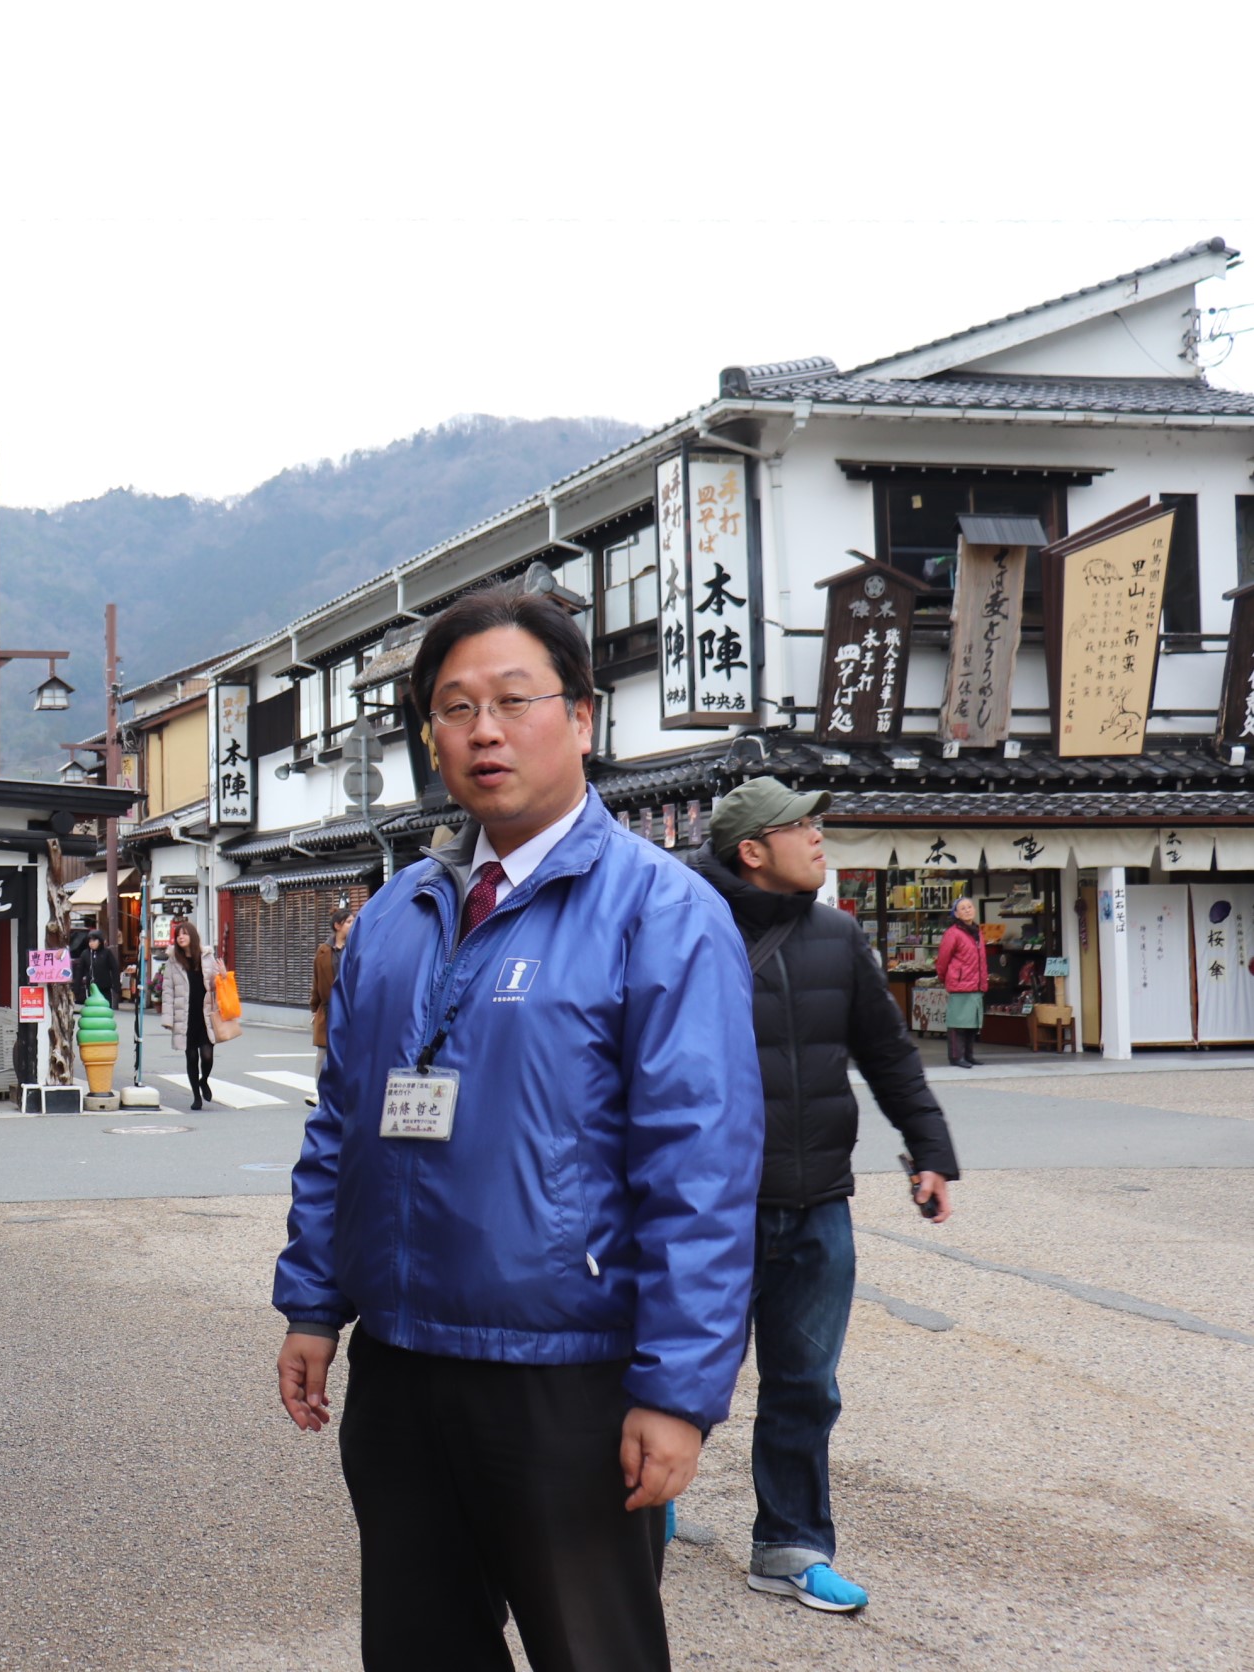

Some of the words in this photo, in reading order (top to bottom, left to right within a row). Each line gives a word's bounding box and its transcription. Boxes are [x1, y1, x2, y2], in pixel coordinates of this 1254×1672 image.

[696, 484, 719, 554] 皿そば
[719, 470, 742, 537] 手打
[1128, 559, 1146, 598] 里山
[661, 559, 686, 677] 本陣
[694, 562, 748, 681] 本陣
[828, 643, 862, 733] 皿そば処
[858, 628, 881, 692] 本手打
[876, 627, 901, 733] 職人手仕事一筋
[701, 692, 747, 711] 中央店
[220, 738, 249, 800] 本陣
[1114, 888, 1126, 933] 出石そば
[1207, 929, 1226, 980] 桜傘
